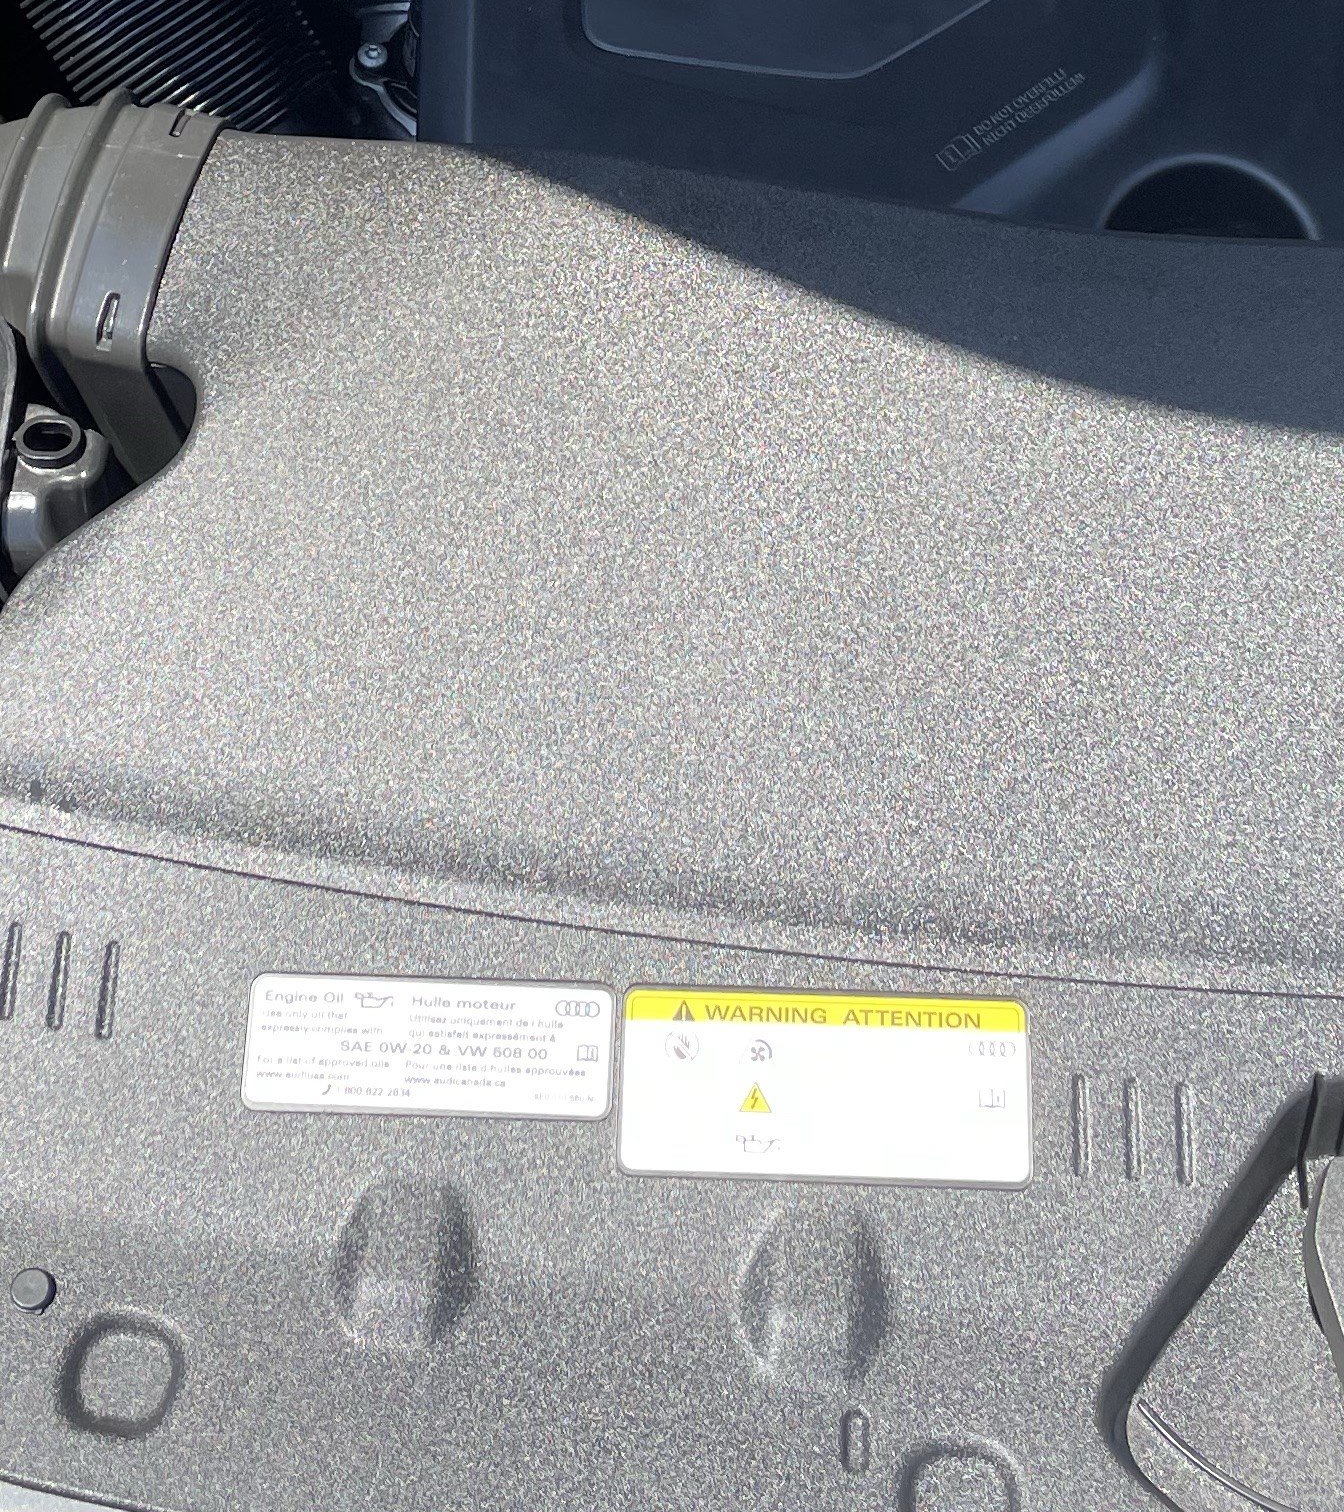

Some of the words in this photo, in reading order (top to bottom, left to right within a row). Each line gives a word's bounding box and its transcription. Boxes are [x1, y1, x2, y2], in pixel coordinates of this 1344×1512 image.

[264, 990, 318, 1004] Engine
[323, 991, 344, 1004] Oil
[411, 996, 452, 1009] Huile
[456, 1000, 516, 1011] moteur
[704, 1004, 828, 1025] WARNING
[842, 1008, 982, 1030] ATTENTION
[340, 1040, 373, 1053] SAE
[379, 1041, 432, 1055] 0W20
[438, 1044, 451, 1056] &
[458, 1045, 487, 1058] VW
[527, 1048, 548, 1060] 00
